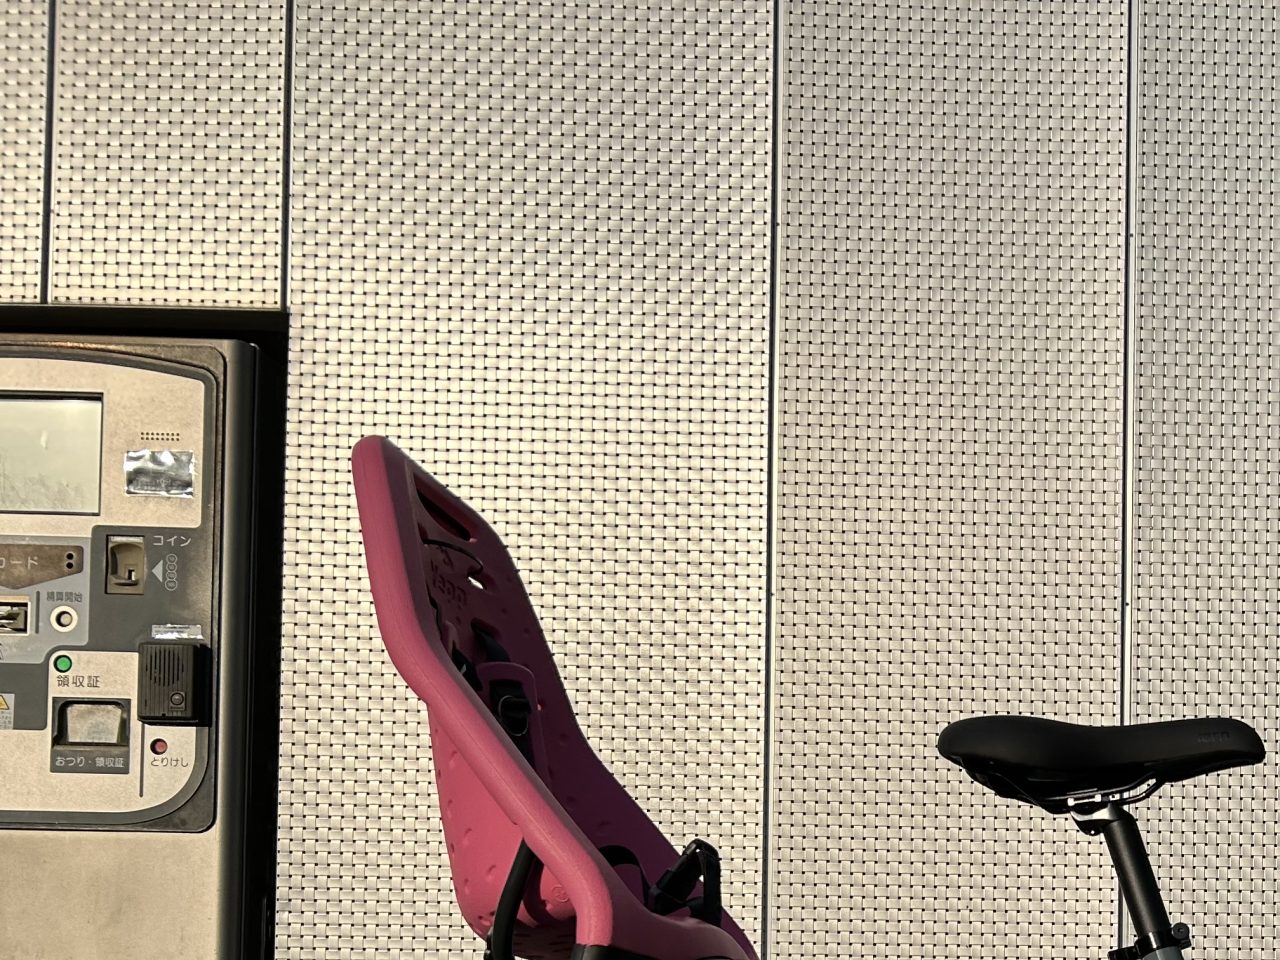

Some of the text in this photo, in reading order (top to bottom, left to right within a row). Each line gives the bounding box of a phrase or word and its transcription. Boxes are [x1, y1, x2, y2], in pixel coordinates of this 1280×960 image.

[152, 534, 192, 548] コイン
[46, 591, 83, 603] 精算開始
[56, 674, 101, 689] 領収証
[55, 755, 124, 769] おつり・領収証
[150, 755, 189, 768] とりけし
